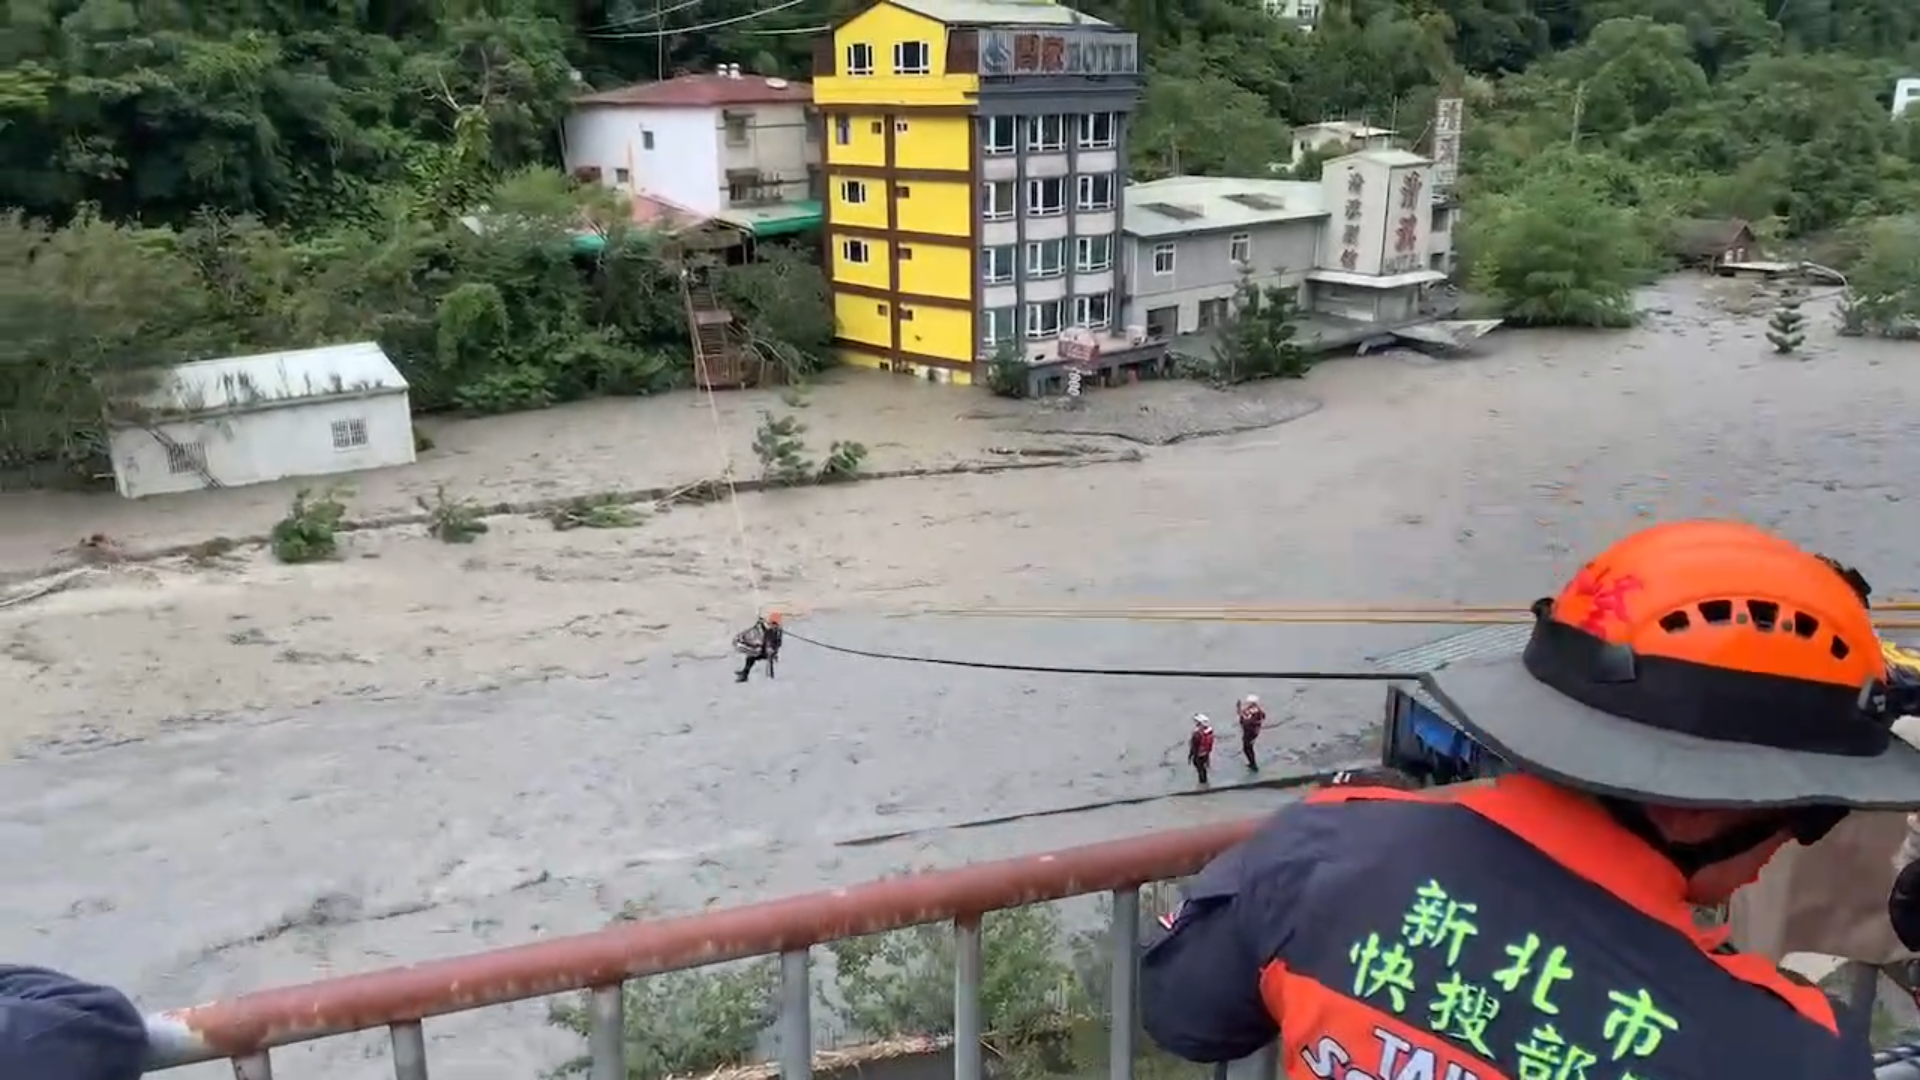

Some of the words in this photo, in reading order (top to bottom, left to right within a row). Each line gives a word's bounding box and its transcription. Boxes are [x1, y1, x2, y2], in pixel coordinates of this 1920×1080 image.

[1348, 932, 1645, 1080] 快搜部
[1402, 879, 1679, 1062] 新北市
